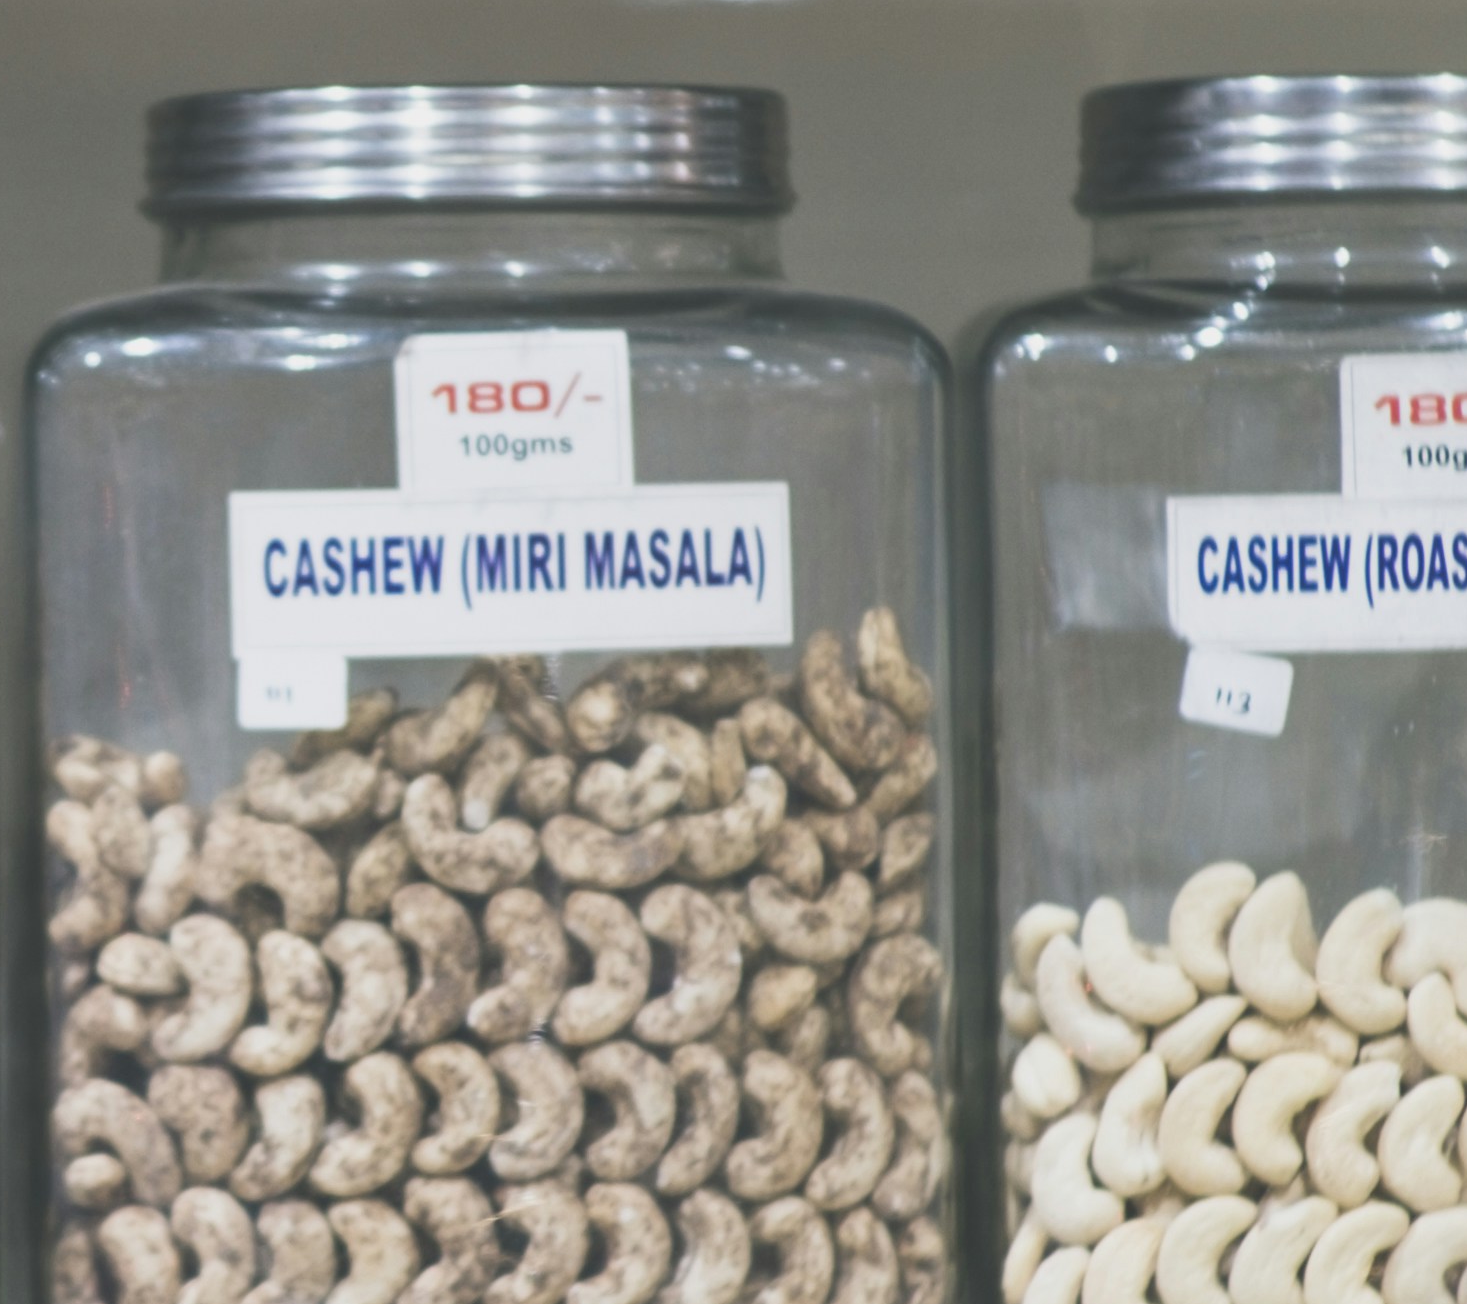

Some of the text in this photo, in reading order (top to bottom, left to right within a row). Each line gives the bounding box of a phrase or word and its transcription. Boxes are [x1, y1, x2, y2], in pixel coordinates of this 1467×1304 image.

[429, 377, 605, 422] 180/-
[460, 433, 574, 463] 100gms
[263, 527, 766, 608] CASHEW (MIRI MASALA)
[1197, 534, 1352, 595] CASHEW
[1215, 687, 1251, 714] 113
